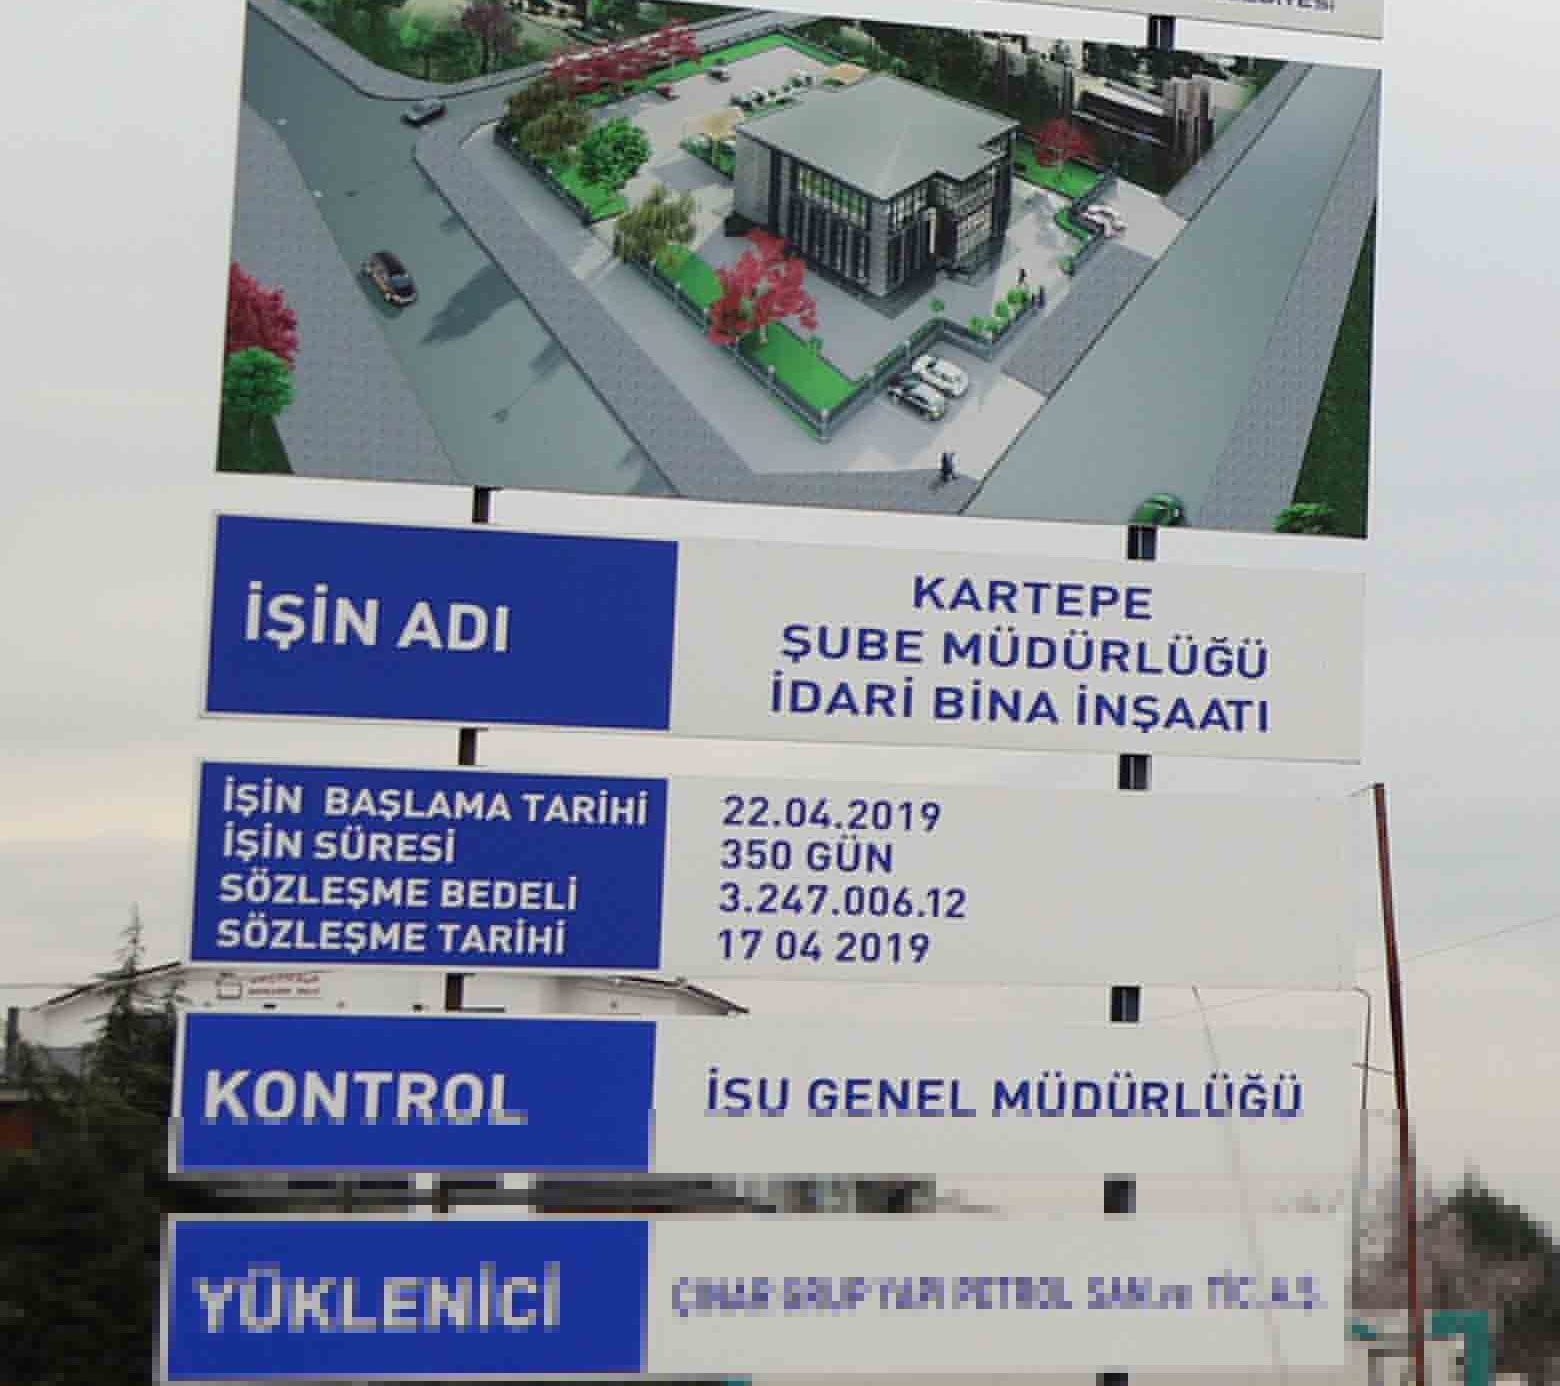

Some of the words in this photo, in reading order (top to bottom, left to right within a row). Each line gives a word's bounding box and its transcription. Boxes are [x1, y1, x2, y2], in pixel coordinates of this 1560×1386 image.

[244, 580, 378, 648] İŞİN
[396, 601, 510, 652] ADI
[912, 575, 1152, 620] KARTEPE
[781, 625, 924, 666] ŞUBE
[941, 625, 1270, 680] MÜDÜRLÜĞÜ
[769, 669, 916, 719] İDARİ
[933, 673, 1059, 725] BİNA
[1074, 681, 1270, 734] İNŞAATI
[223, 775, 304, 818] İŞİN
[323, 786, 512, 824] BAŞLAMA
[521, 789, 649, 827] TARİHİ
[721, 796, 941, 832] 22.04.2019
[222, 822, 304, 863] İŞİN
[312, 825, 456, 864] SÜRESİ
[721, 838, 791, 871] 350
[805, 834, 893, 874] GÜN
[218, 868, 431, 913] SÖZLEŞME
[440, 872, 578, 911] BEDELİ
[719, 883, 967, 920] 3.247.006.12
[215, 913, 428, 957] SÖZLEŞME
[437, 917, 566, 955] TARİHİ
[718, 931, 761, 960] 17
[771, 931, 822, 962] 04
[832, 932, 931, 964] 2019
[203, 1068, 528, 1126] KONTROL
[705, 1064, 794, 1117] İSU
[807, 1076, 977, 1118] GENEL
[992, 1066, 1304, 1118] MÜDÜRLÜĞÜ
[192, 1260, 561, 1335] YÜKLENİCİ
